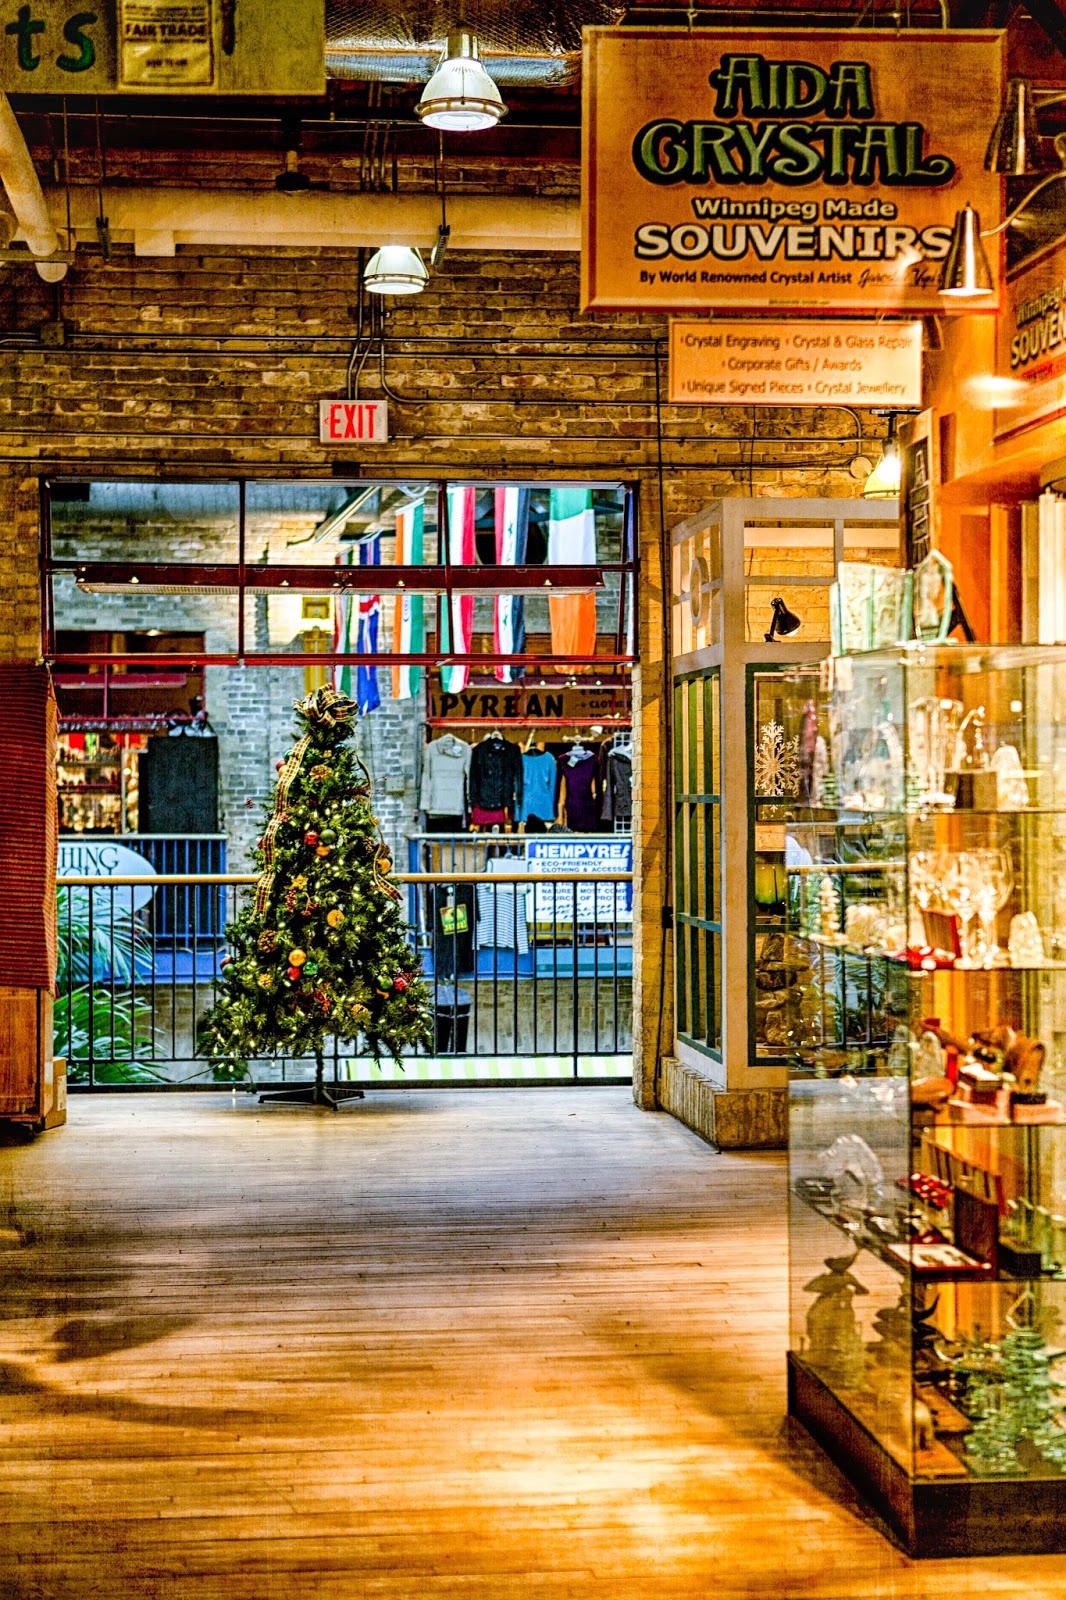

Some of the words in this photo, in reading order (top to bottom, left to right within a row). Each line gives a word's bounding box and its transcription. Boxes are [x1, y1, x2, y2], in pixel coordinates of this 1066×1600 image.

[159, 23, 207, 36] TRADE
[709, 53, 875, 116] AIDA
[633, 118, 955, 184] CRYSTAL
[694, 198, 819, 224] Winnipeg
[823, 198, 897, 219] Made
[635, 224, 955, 260] SOUVENIRS
[640, 271, 655, 286] By
[659, 271, 697, 283] World
[701, 271, 767, 284] Renowned
[770, 271, 814, 286] Crystal
[818, 271, 852, 284] Artist
[685, 334, 723, 350] Crystal
[726, 334, 780, 351] Engraving
[793, 334, 831, 350] Crystal
[833, 335, 842, 348] &
[846, 335, 875, 348] Glass
[878, 336, 913, 352] Repair
[727, 358, 781, 373] Corporate
[785, 358, 810, 371] Gifts
[822, 358, 863, 372] Awards
[687, 381, 726, 397] Unique
[729, 381, 767, 396] Signed
[769, 381, 803, 394] Pieces
[815, 381, 852, 396] Crystal
[857, 382, 907, 397] Jewellery
[330, 404, 378, 439] EXIT
